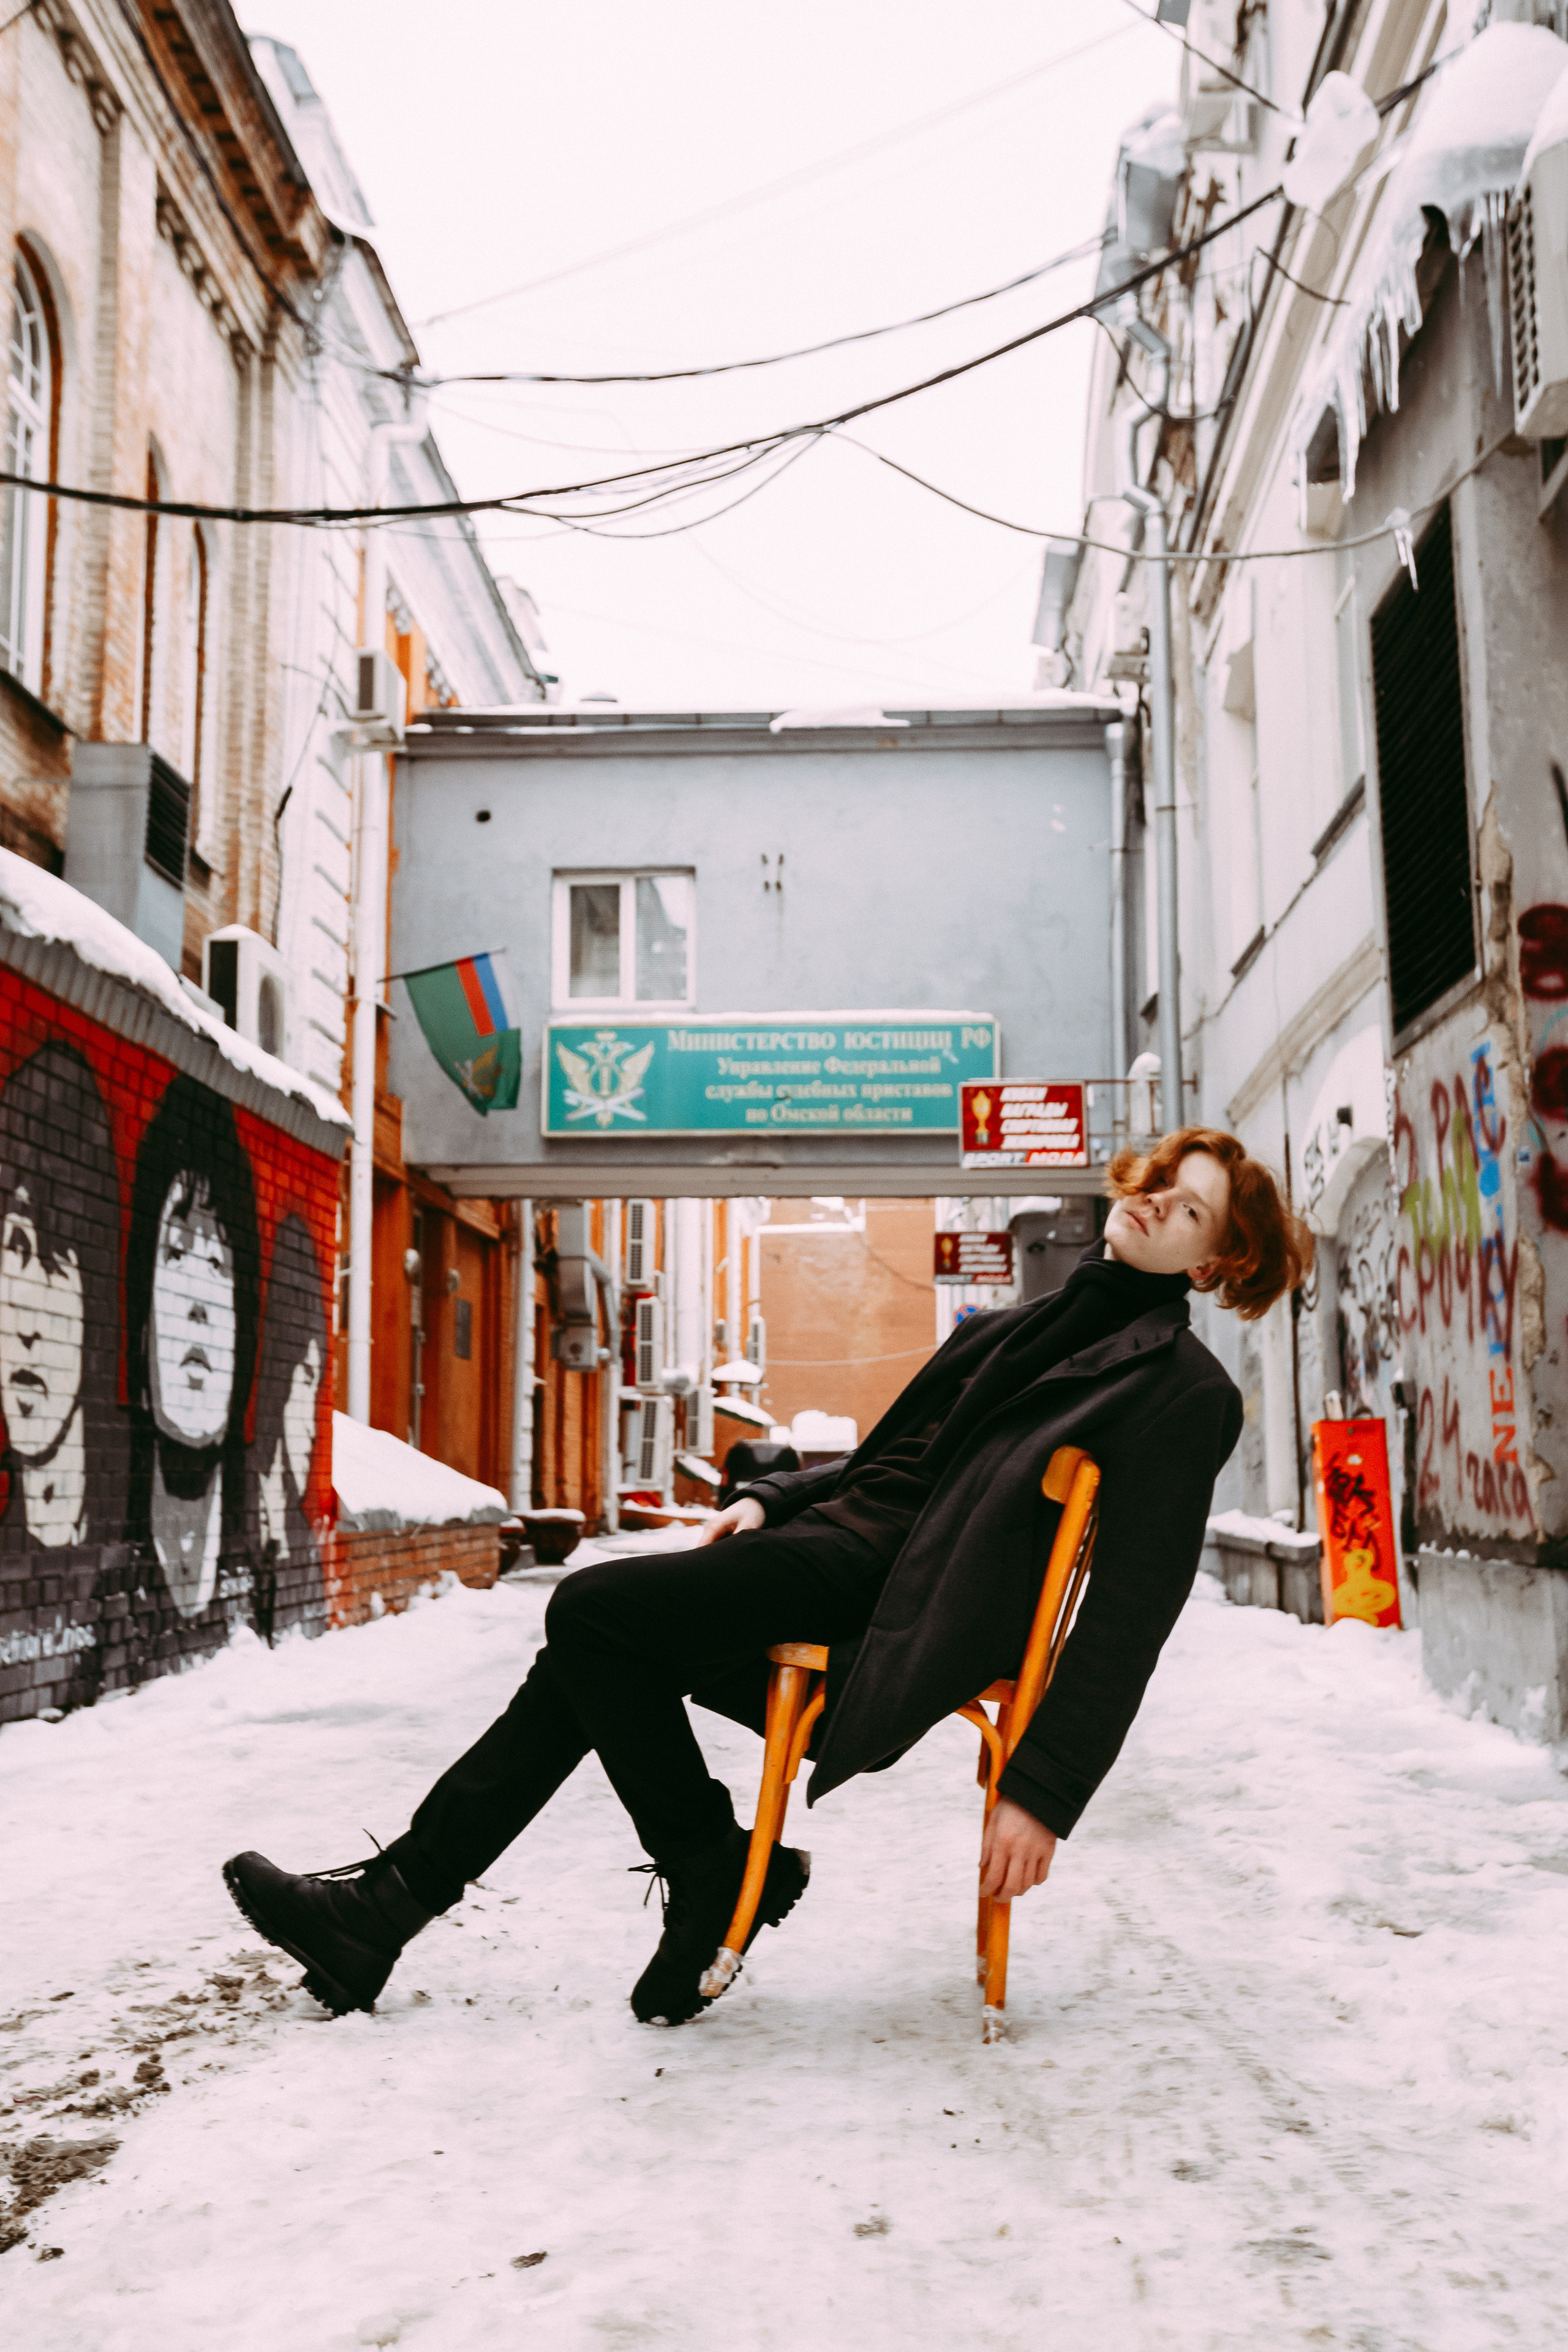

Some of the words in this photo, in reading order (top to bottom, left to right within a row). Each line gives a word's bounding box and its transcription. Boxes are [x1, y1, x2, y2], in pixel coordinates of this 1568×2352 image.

[961, 1027, 991, 1049] РФ
[718, 1057, 820, 1079] Управление
[824, 1056, 940, 1078] Федеральной
[706, 1080, 773, 1102] службы
[776, 1080, 856, 1101] судебных
[861, 1083, 952, 1102] приставов
[745, 1108, 768, 1123] по
[770, 1104, 839, 1122] Омской
[843, 1104, 912, 1122] области
